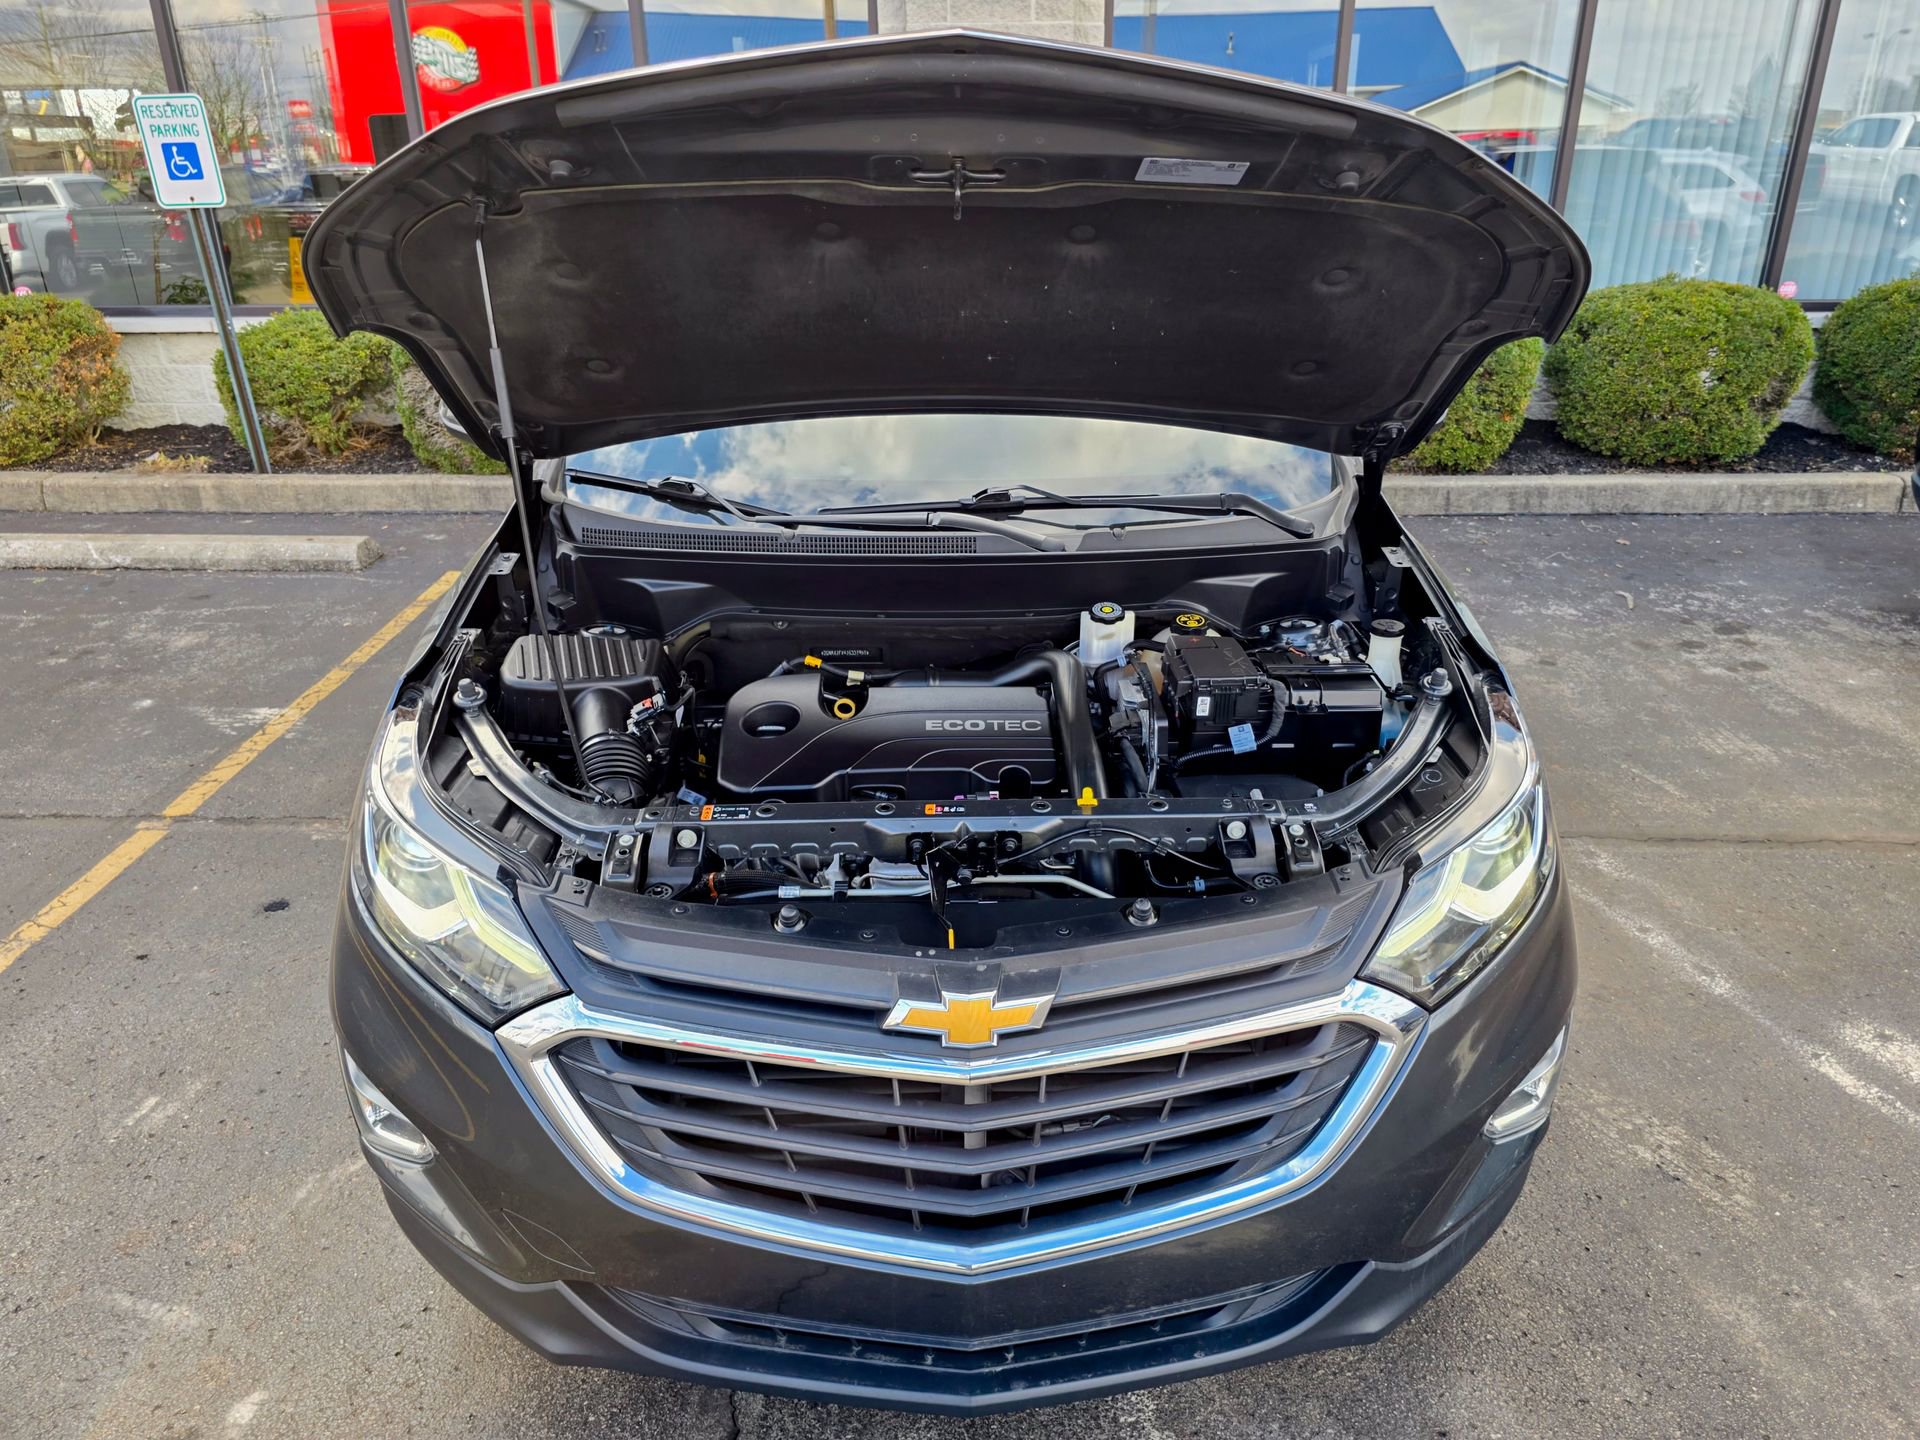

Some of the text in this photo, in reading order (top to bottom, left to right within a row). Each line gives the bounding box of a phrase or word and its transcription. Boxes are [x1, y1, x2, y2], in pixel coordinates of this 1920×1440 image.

[140, 103, 199, 119] RESERVED
[149, 123, 200, 138] PARKING
[925, 719, 1042, 732] ECOTEC
